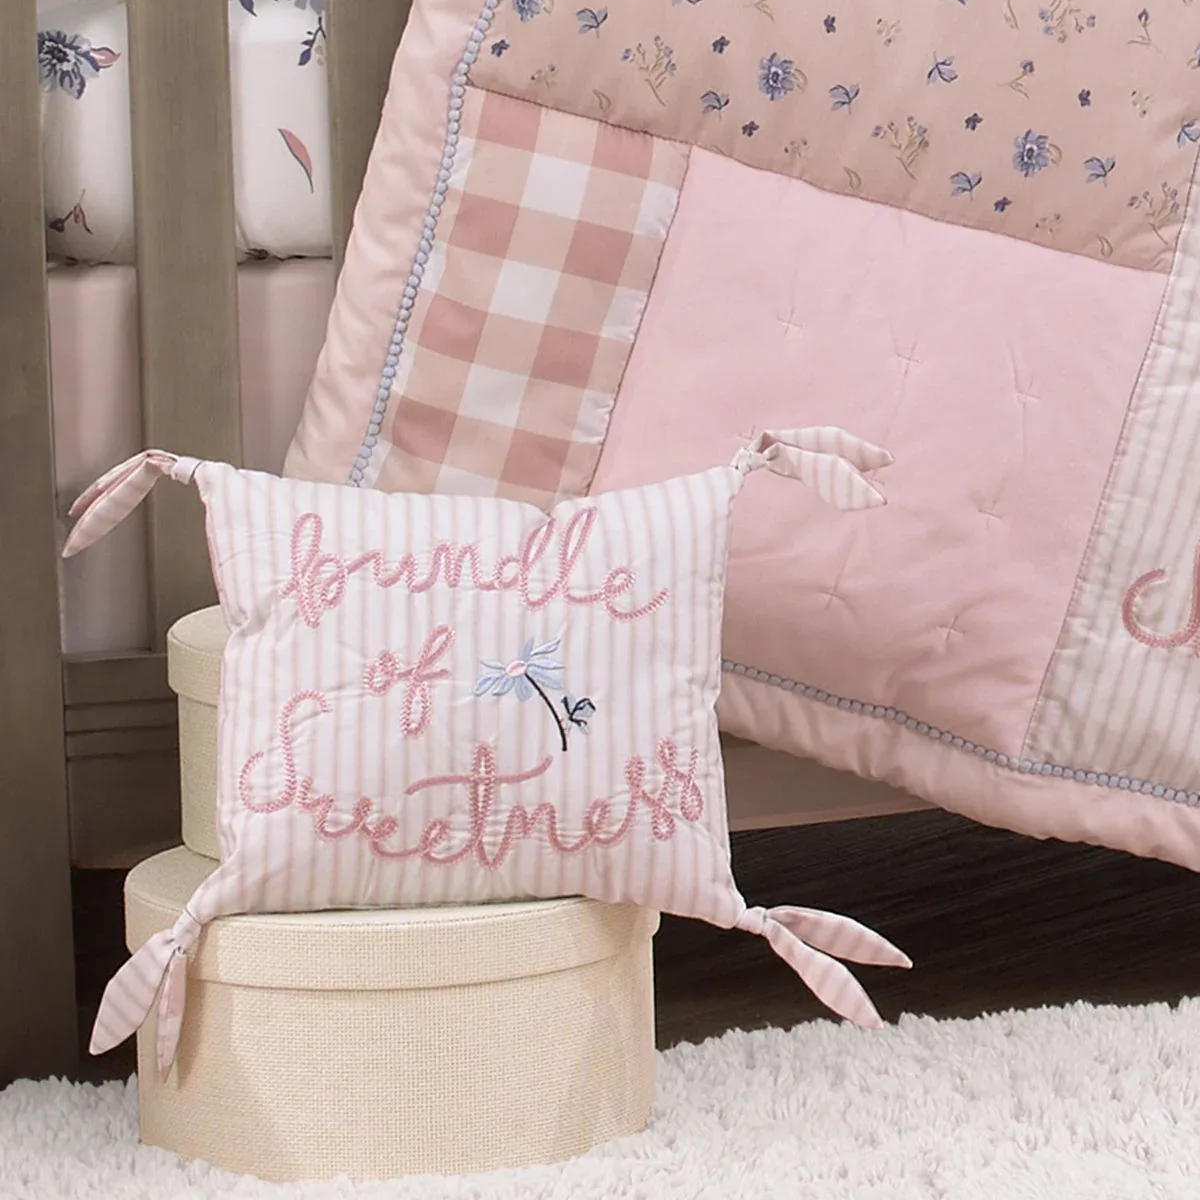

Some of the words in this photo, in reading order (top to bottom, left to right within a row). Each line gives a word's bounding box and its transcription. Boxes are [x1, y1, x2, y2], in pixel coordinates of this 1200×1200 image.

[280, 506, 671, 629] bundle
[363, 623, 457, 738] of
[239, 690, 704, 871] Sweetness
